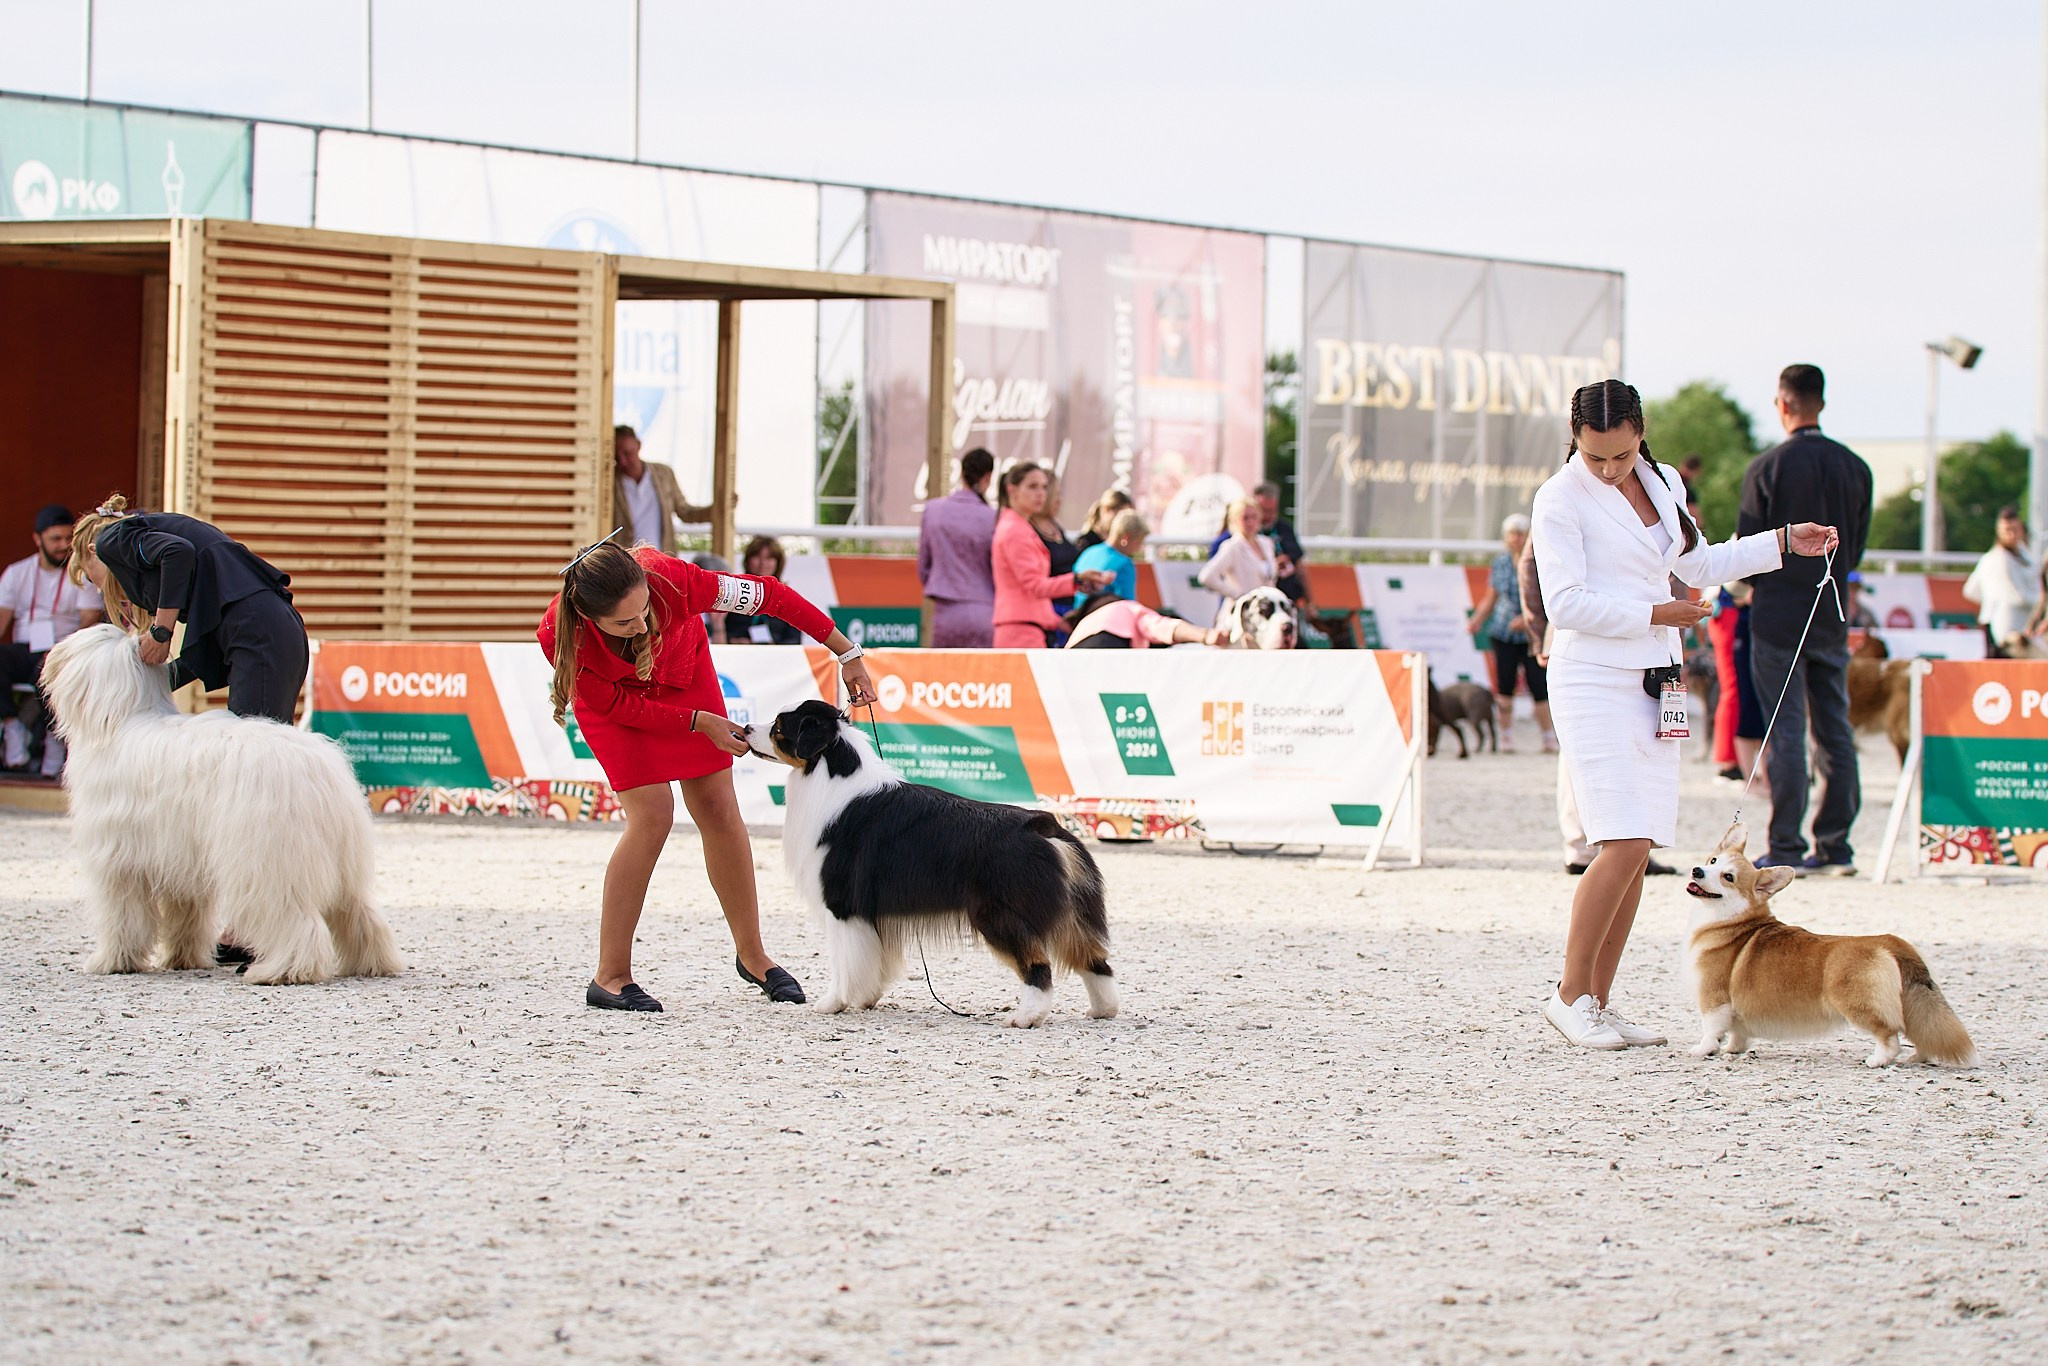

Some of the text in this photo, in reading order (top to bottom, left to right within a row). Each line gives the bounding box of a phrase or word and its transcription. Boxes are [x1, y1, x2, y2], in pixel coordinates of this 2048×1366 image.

[62, 178, 120, 213] РКФ
[922, 233, 1062, 287] МИРАТОРГ
[622, 312, 679, 374] ina
[1316, 338, 1444, 411] BEST
[735, 582, 751, 611] 0018
[866, 623, 918, 643] РОССИЯ
[373, 671, 467, 697] РОССИЯ
[911, 681, 1012, 709] РОССИЯ
[1115, 705, 1148, 724] 8-9
[1252, 702, 1345, 719] Европейский
[1663, 710, 1685, 724] 0742
[1252, 721, 1355, 738] Ветеринарный
[1126, 742, 1158, 758] 2024
